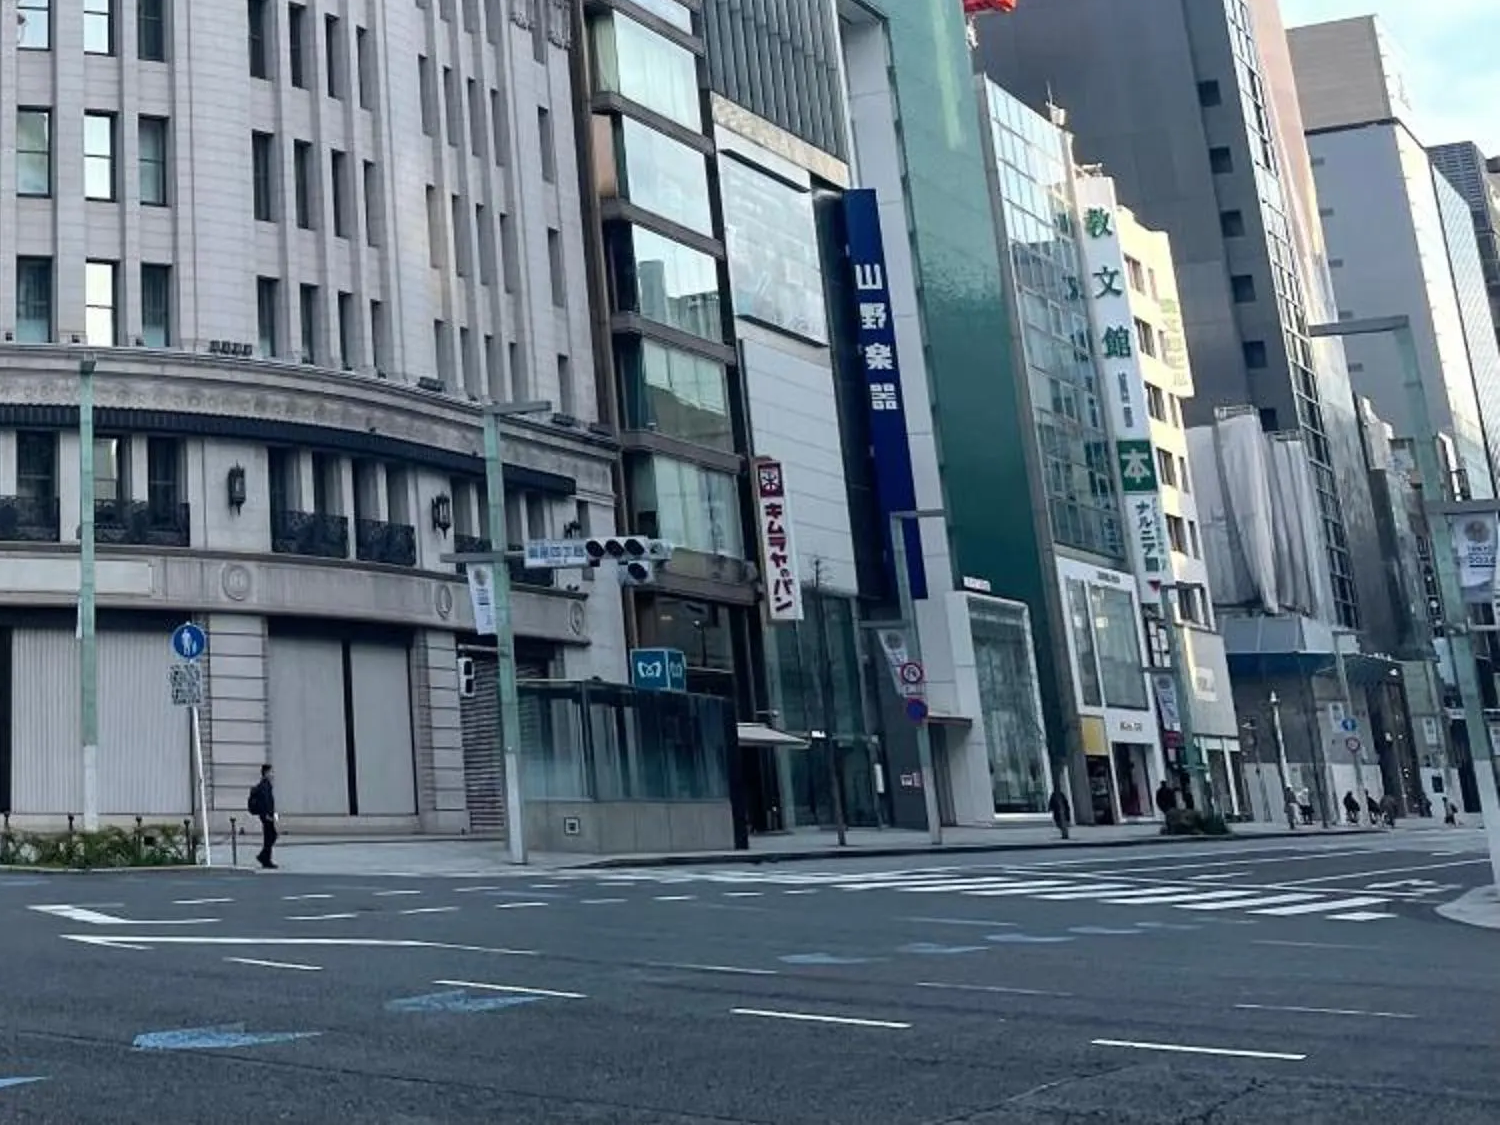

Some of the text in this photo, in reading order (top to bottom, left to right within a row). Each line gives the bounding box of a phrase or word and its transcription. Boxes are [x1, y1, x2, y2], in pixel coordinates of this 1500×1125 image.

[854, 263, 899, 411] 山野楽器
[1083, 206, 1132, 358] 教文館
[1119, 448, 1152, 484] 本
[764, 502, 794, 613] キムラヤのパン
